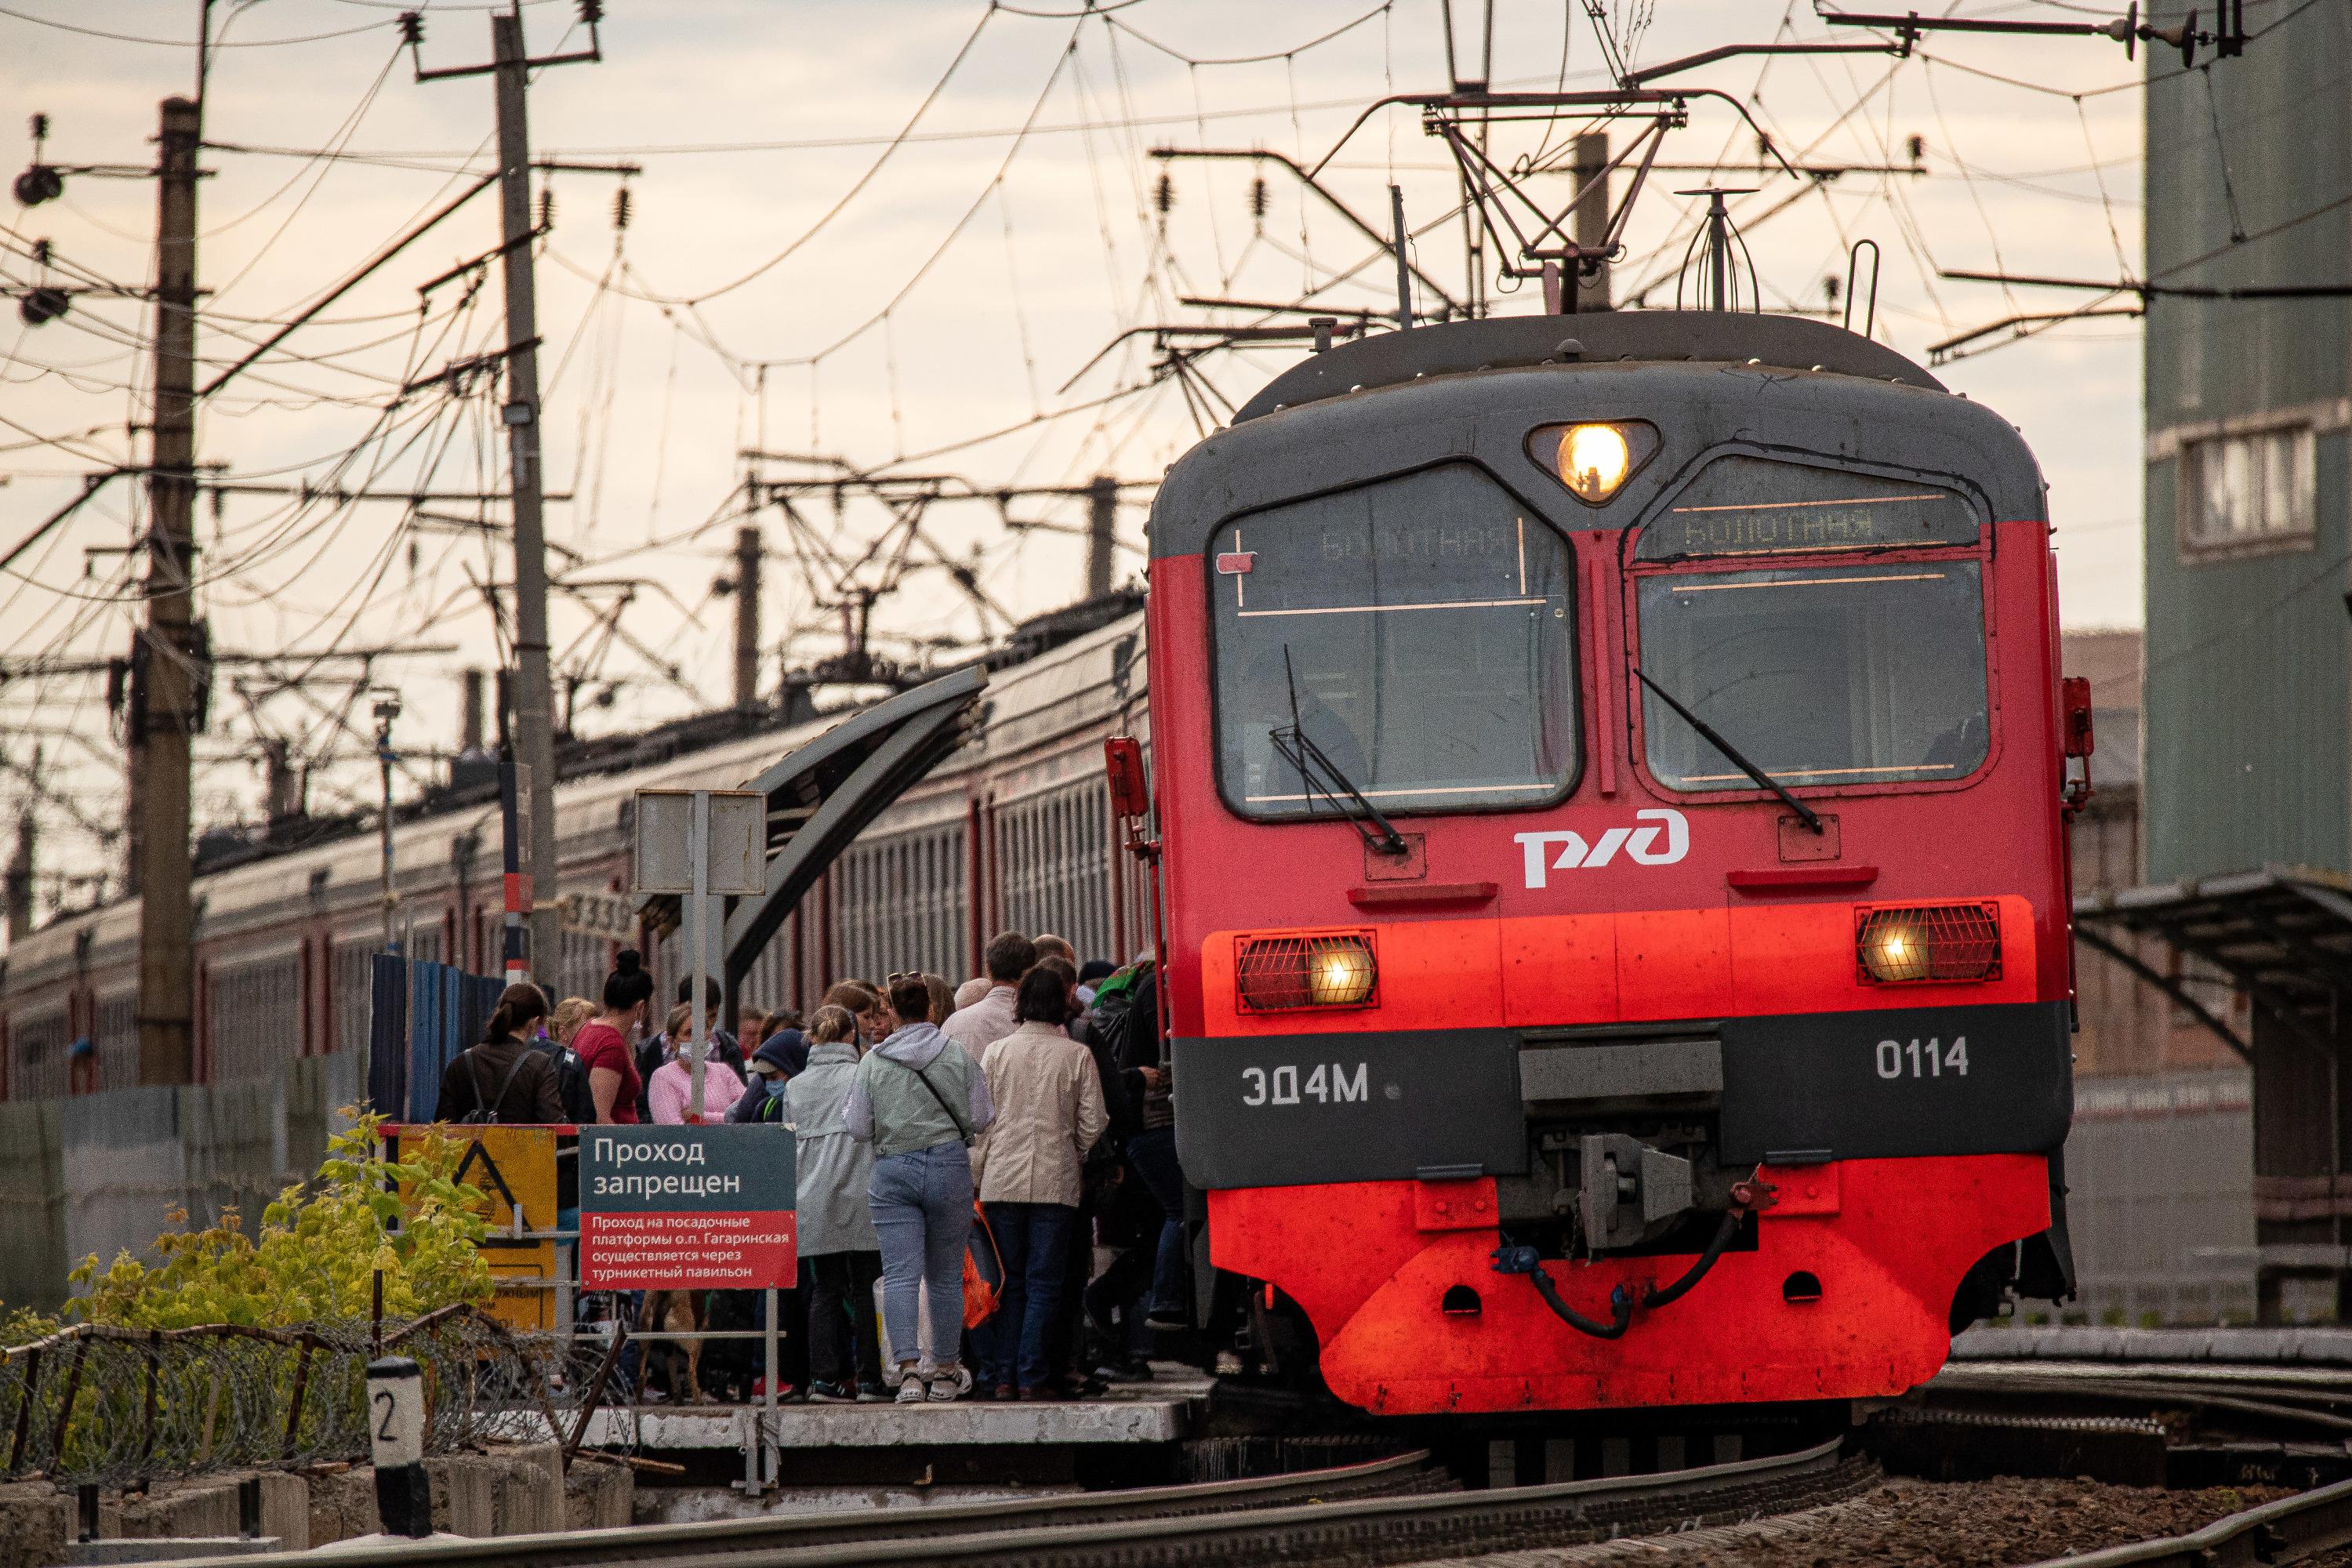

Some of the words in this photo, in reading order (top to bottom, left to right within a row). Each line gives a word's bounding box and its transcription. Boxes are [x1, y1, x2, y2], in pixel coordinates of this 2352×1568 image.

[1514, 808, 1690, 888] РЖД
[1876, 1036, 1969, 1079] 0114
[1242, 1062, 1367, 1105] ЭД4М
[593, 1138, 705, 1168] Проход
[593, 1175, 740, 1200] запрещен
[592, 1216, 644, 1231] Проход
[647, 1218, 663, 1228] на
[666, 1217, 751, 1229] посадочные
[592, 1234, 672, 1249] платформы
[675, 1235, 700, 1245] о.п.
[703, 1232, 789, 1247] Гагаринская
[592, 1250, 699, 1265] осуществляется
[702, 1250, 741, 1264] через
[592, 1265, 682, 1280] турникетный
[686, 1266, 752, 1278] павильон
[375, 1392, 397, 1441] 2
